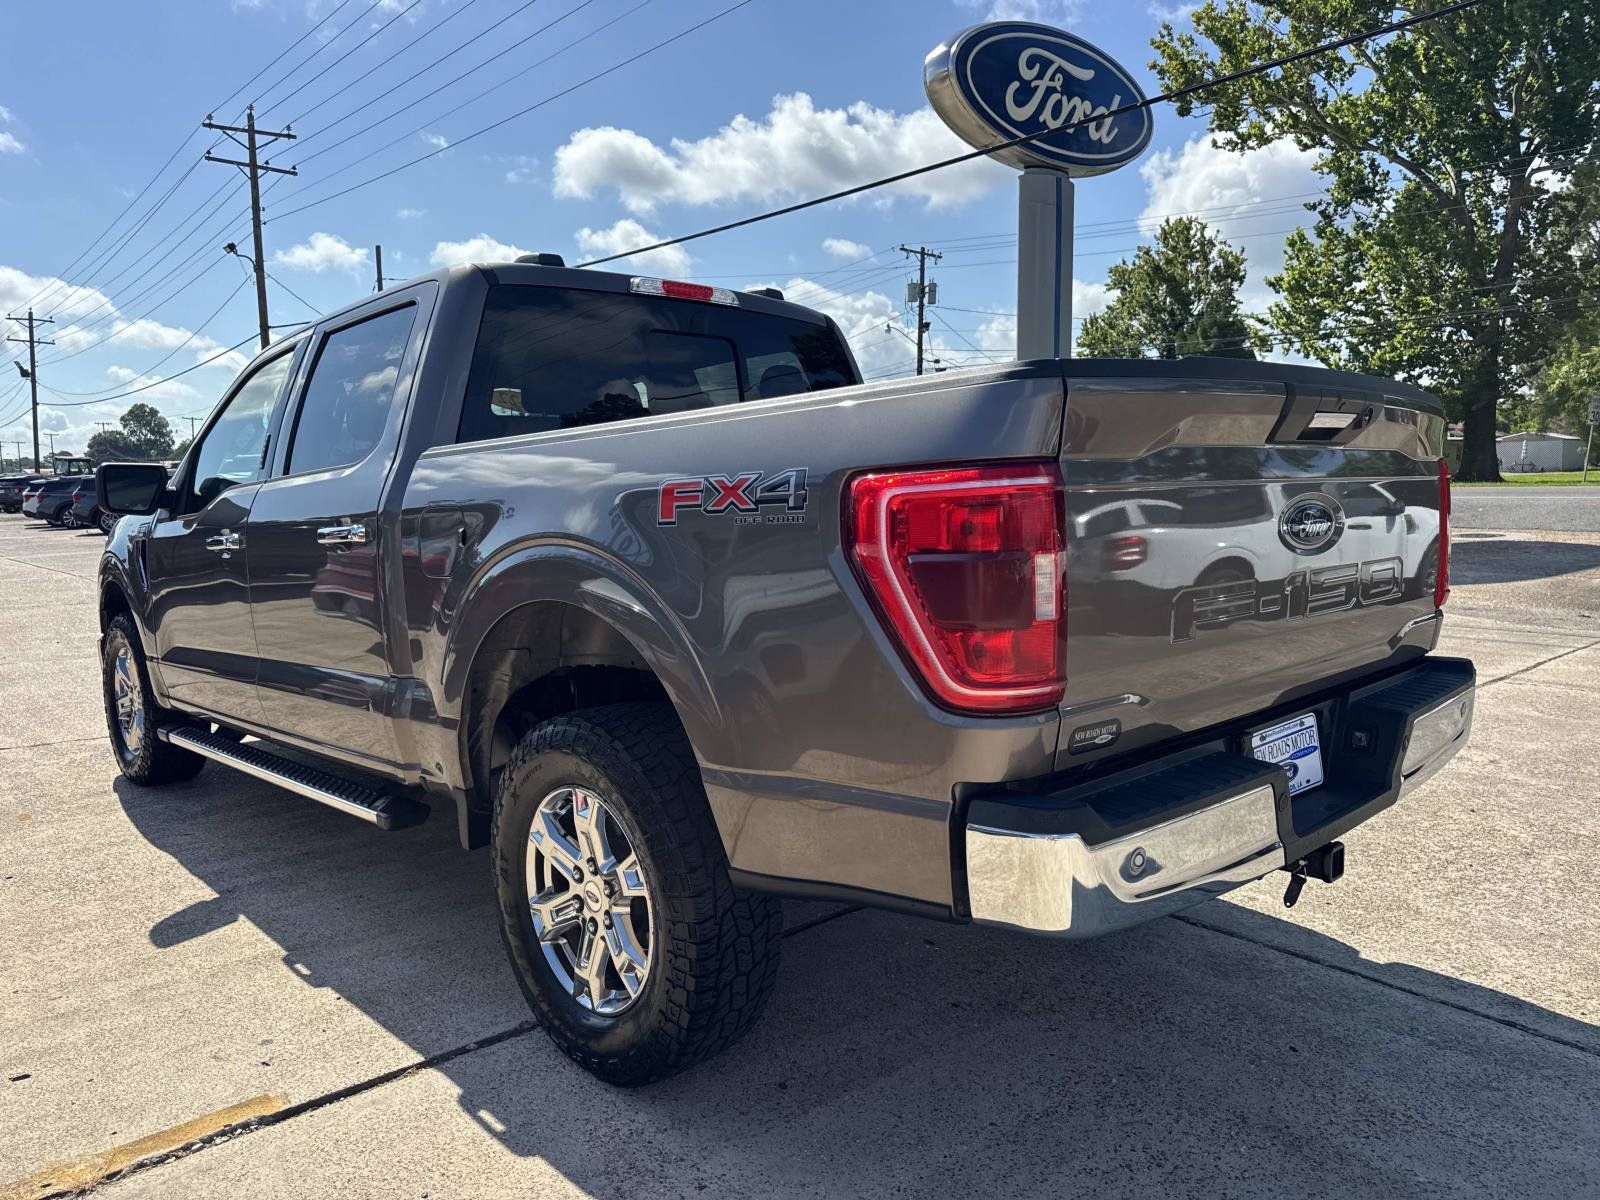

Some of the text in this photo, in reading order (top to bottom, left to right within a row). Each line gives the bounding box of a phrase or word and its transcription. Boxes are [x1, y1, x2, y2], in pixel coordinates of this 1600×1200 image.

[1005, 47, 1122, 145] Ford
[656, 467, 809, 527] FX4
[734, 514, 806, 525] OFF ROAD
[1299, 509, 1332, 538] Ford
[1170, 555, 1404, 645] F-150
[1254, 729, 1316, 761] EW ROADS MOTOR
